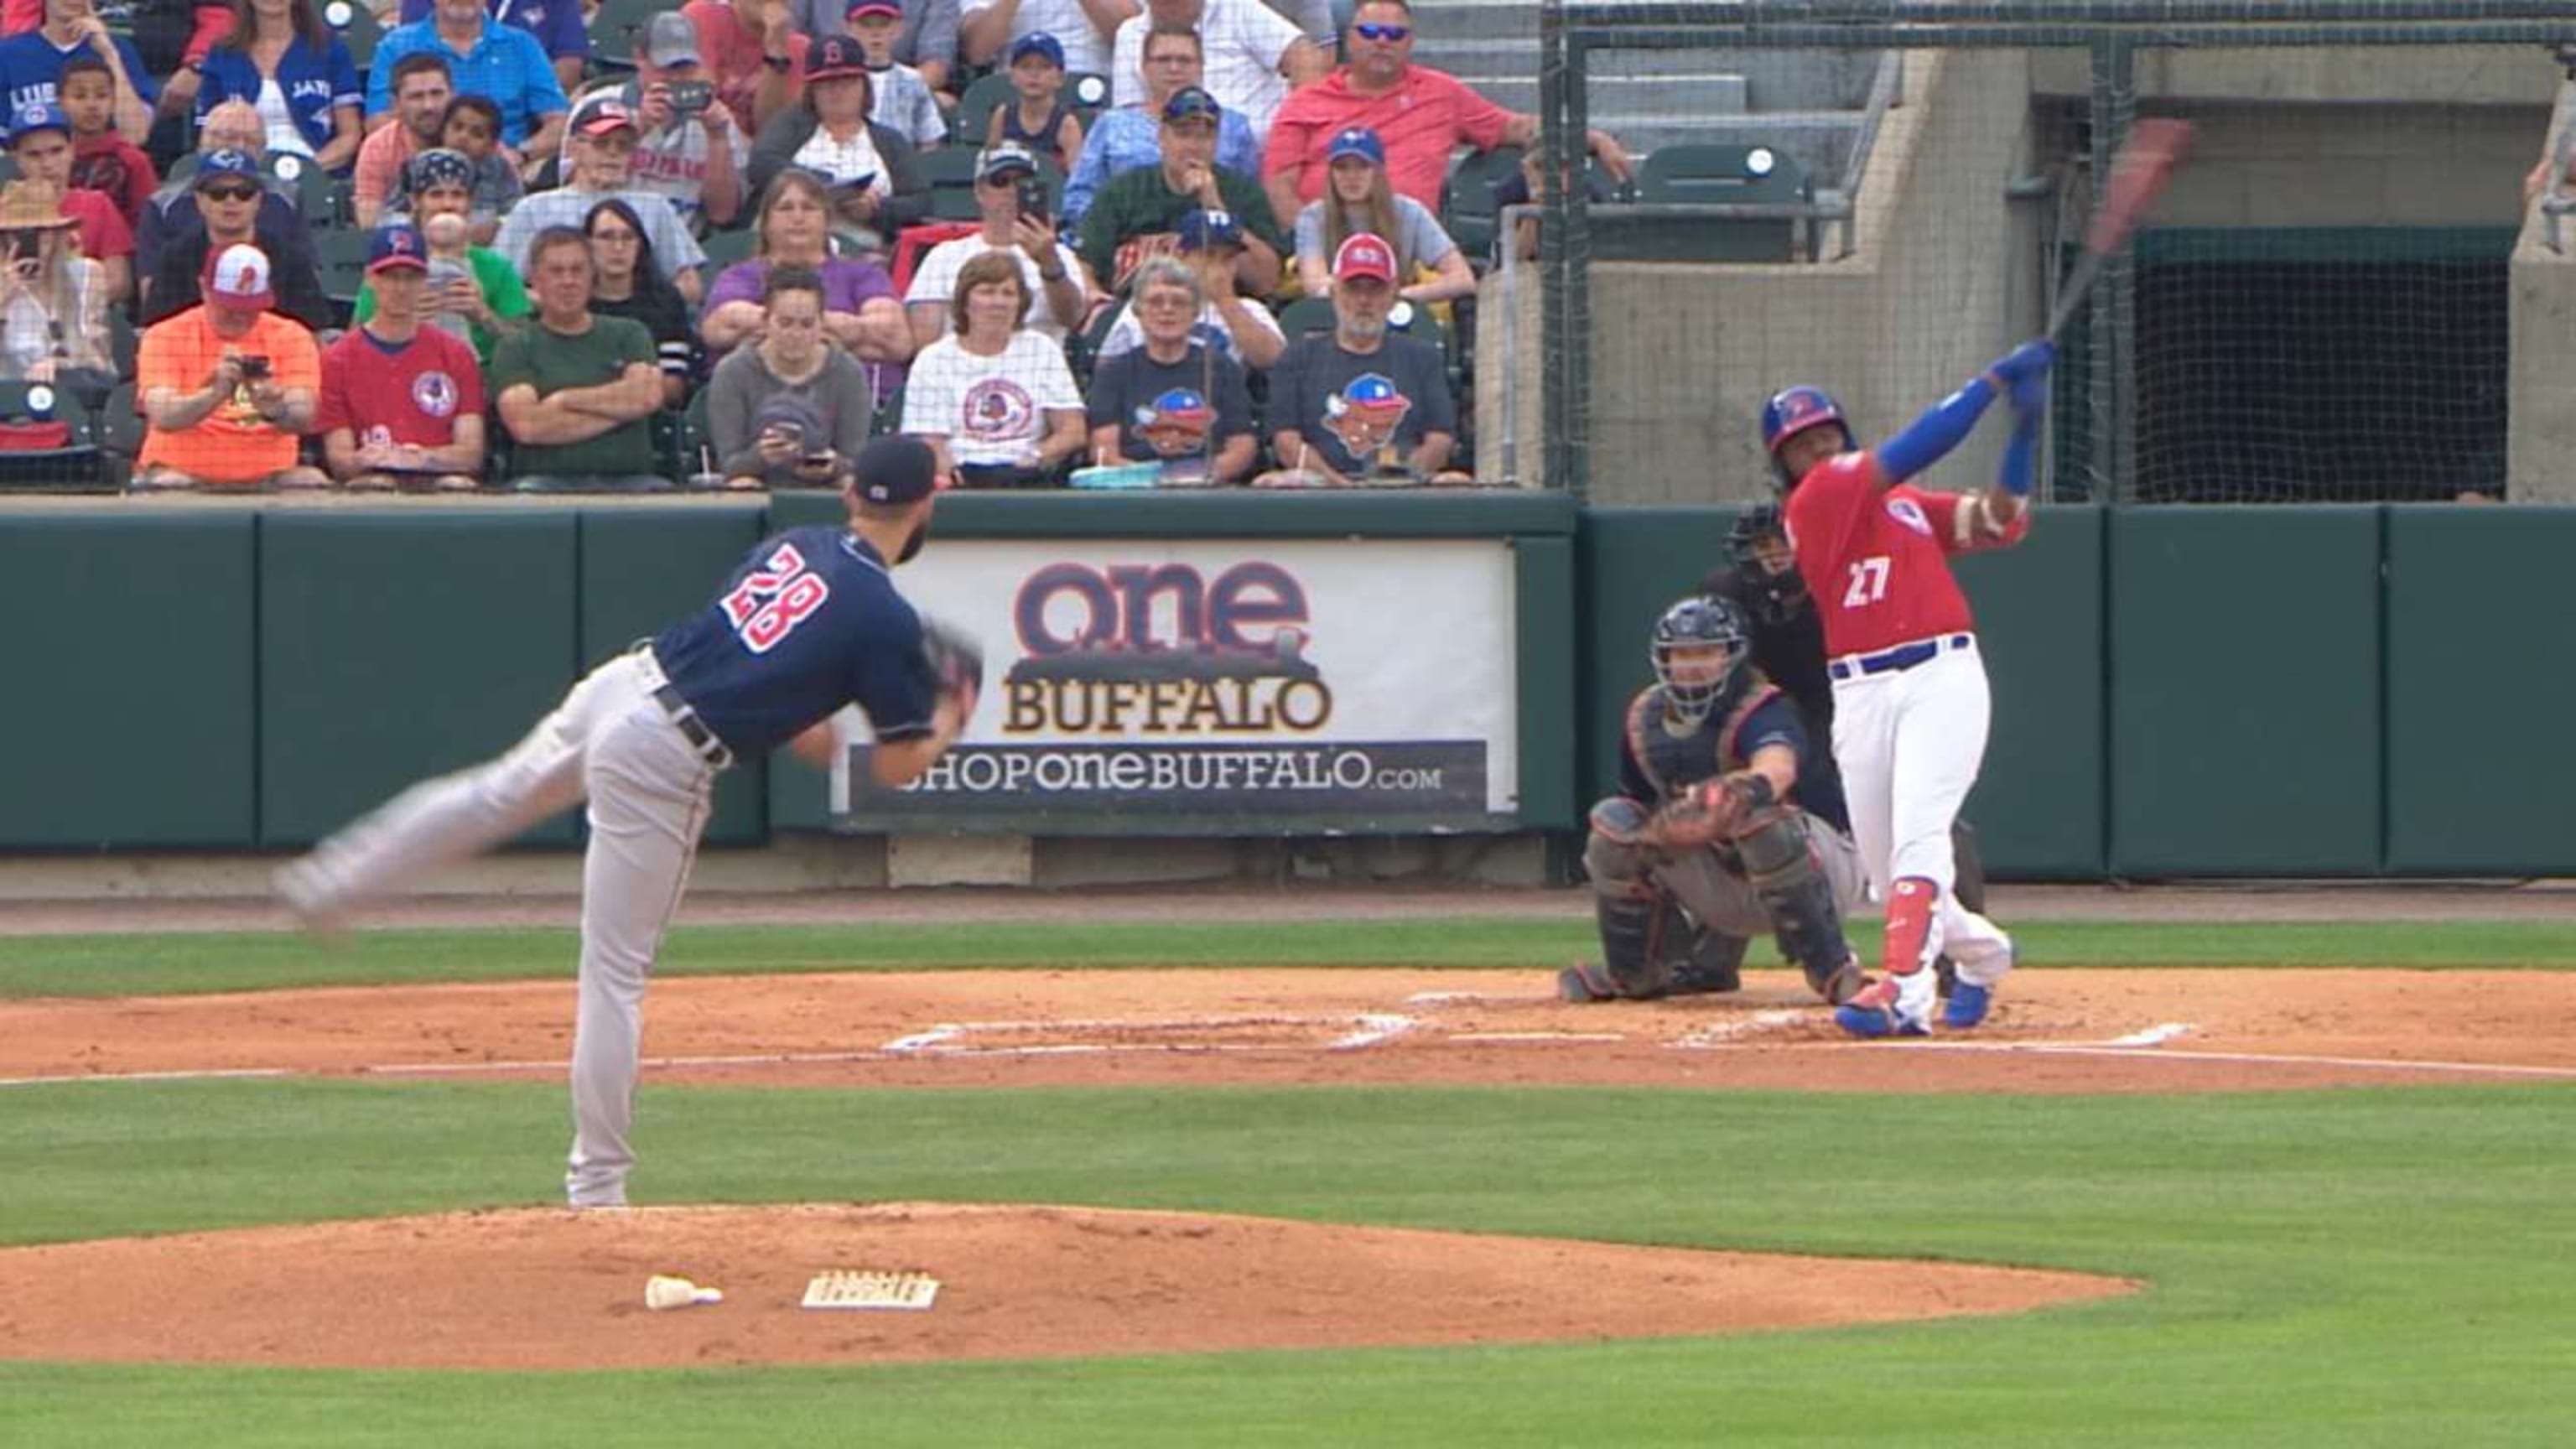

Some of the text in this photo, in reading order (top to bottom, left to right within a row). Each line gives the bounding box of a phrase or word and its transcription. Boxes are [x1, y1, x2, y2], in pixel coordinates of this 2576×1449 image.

[719, 543, 829, 654] 28
[1014, 561, 1310, 659] one
[1843, 556, 1892, 607] 27
[1000, 675, 1333, 735] BUFFALO
